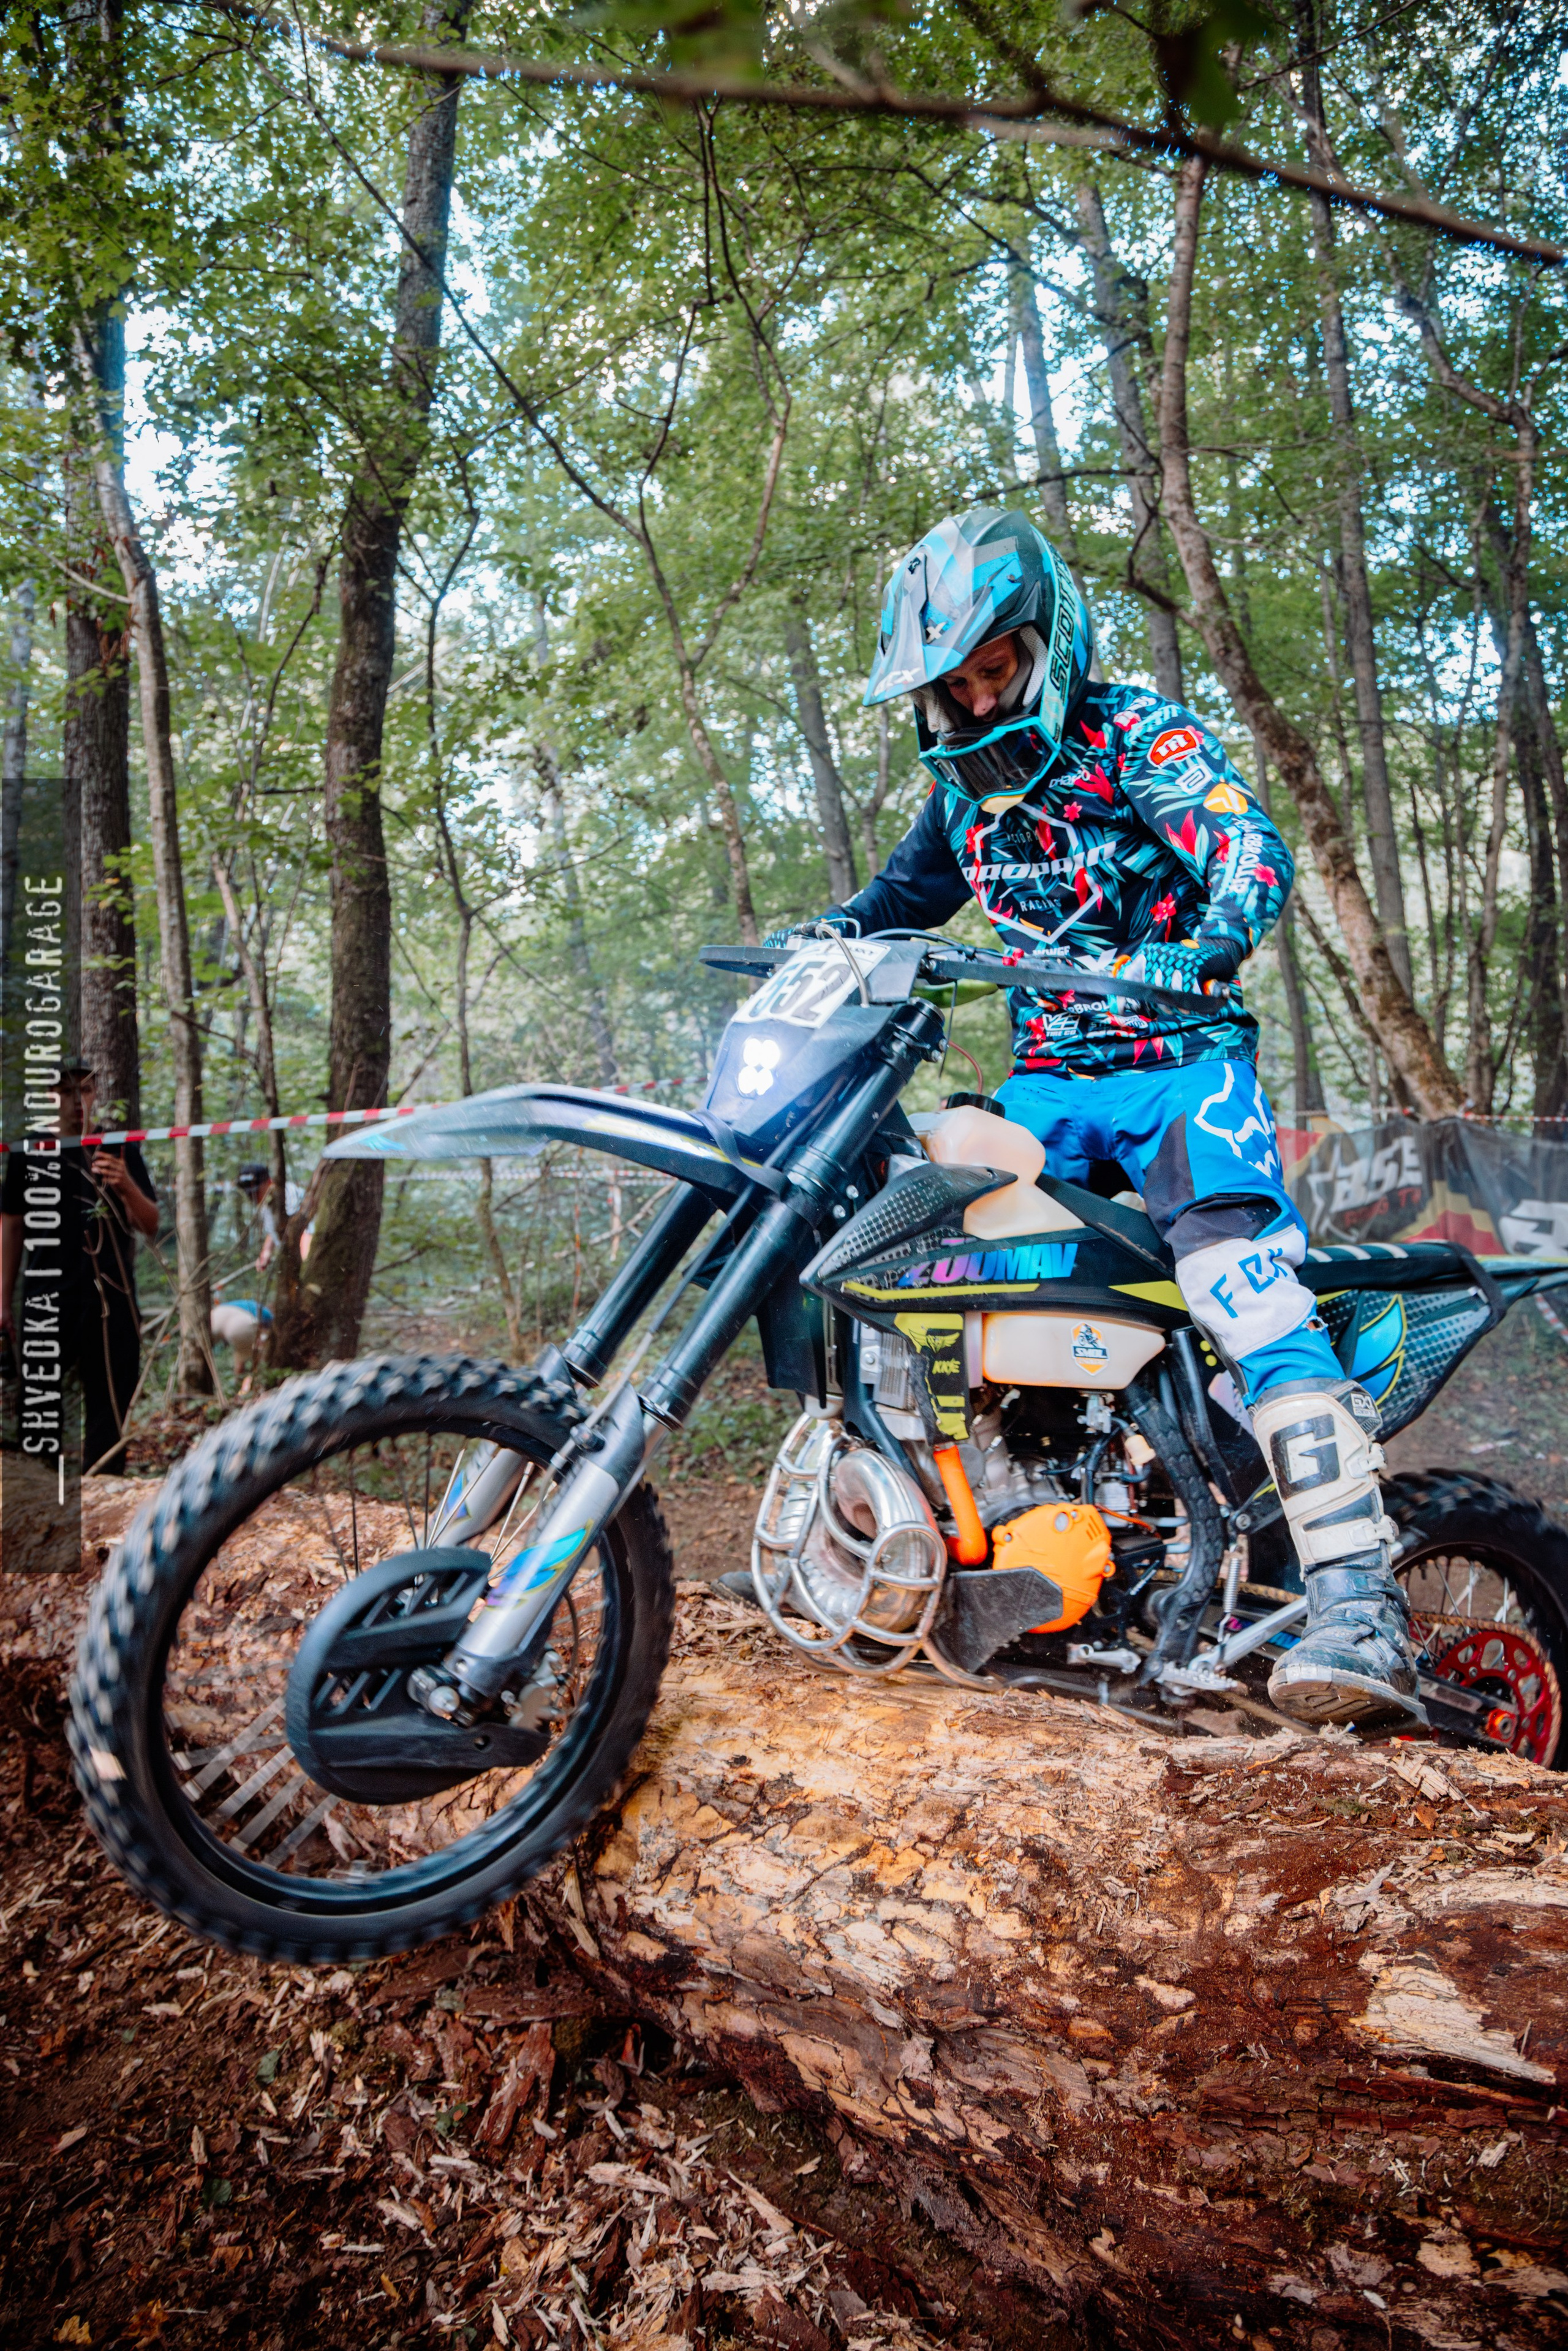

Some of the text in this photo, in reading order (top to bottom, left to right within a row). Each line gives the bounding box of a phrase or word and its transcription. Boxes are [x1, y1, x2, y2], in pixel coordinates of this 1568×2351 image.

[1006, 831, 1039, 843] ICTORY
[1020, 898, 1062, 912] RACING
[1209, 1247, 1288, 1319] FOX
